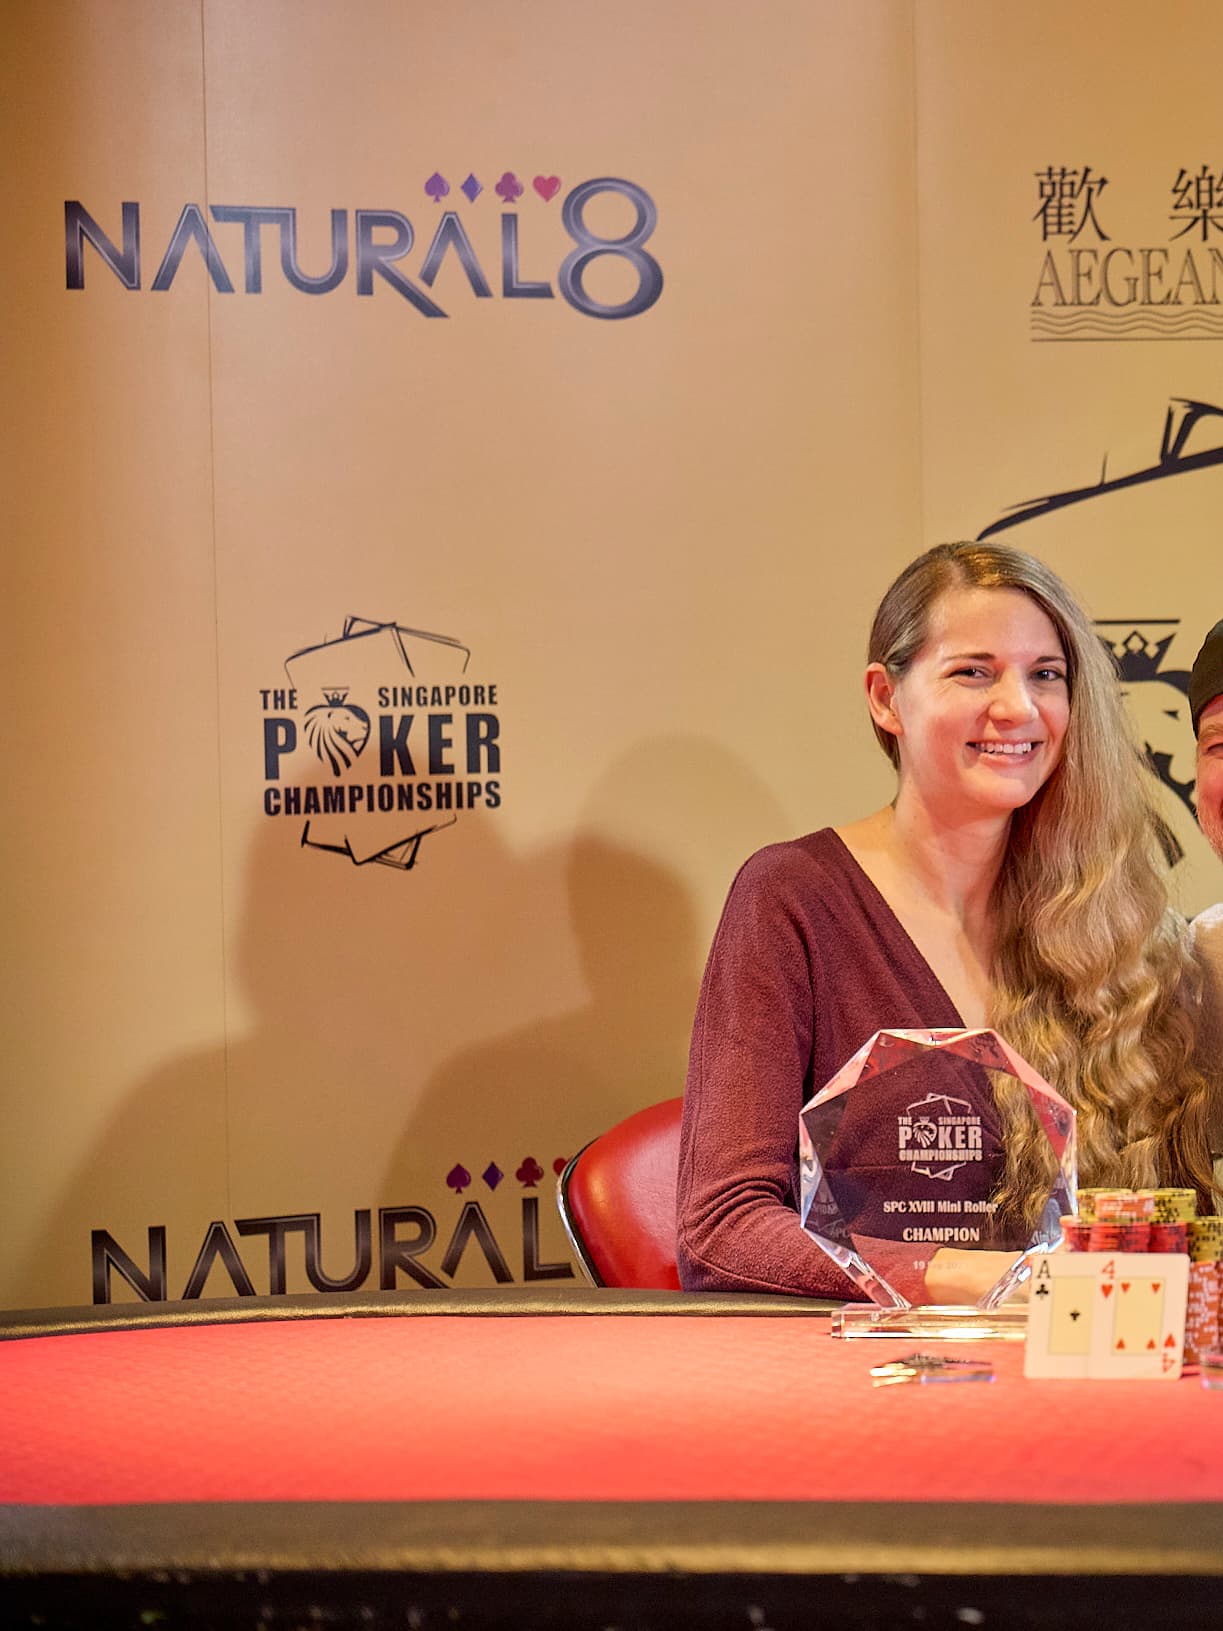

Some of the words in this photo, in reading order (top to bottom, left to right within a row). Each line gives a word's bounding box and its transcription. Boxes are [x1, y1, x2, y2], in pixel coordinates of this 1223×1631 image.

[64, 176, 664, 320] NATURAL8
[259, 689, 298, 711] THE
[378, 684, 498, 708] SINGAPORE
[264, 781, 501, 816] CHAMPIONSHIPS
[898, 1116, 912, 1126] THE
[938, 1116, 981, 1126] SINGAPORE
[899, 1149, 983, 1162] CHAMPIONSHIPS
[883, 1200, 906, 1213] SPC
[908, 1200, 935, 1213] XVIII
[937, 1200, 961, 1213] Mini
[963, 1200, 998, 1214] Roller
[902, 1227, 980, 1242] CHAMPION
[91, 1197, 575, 1304] NATURAL
[1036, 1259, 1051, 1279] A
[1101, 1259, 1115, 1280] 4
[1162, 1353, 1176, 1374] 4
